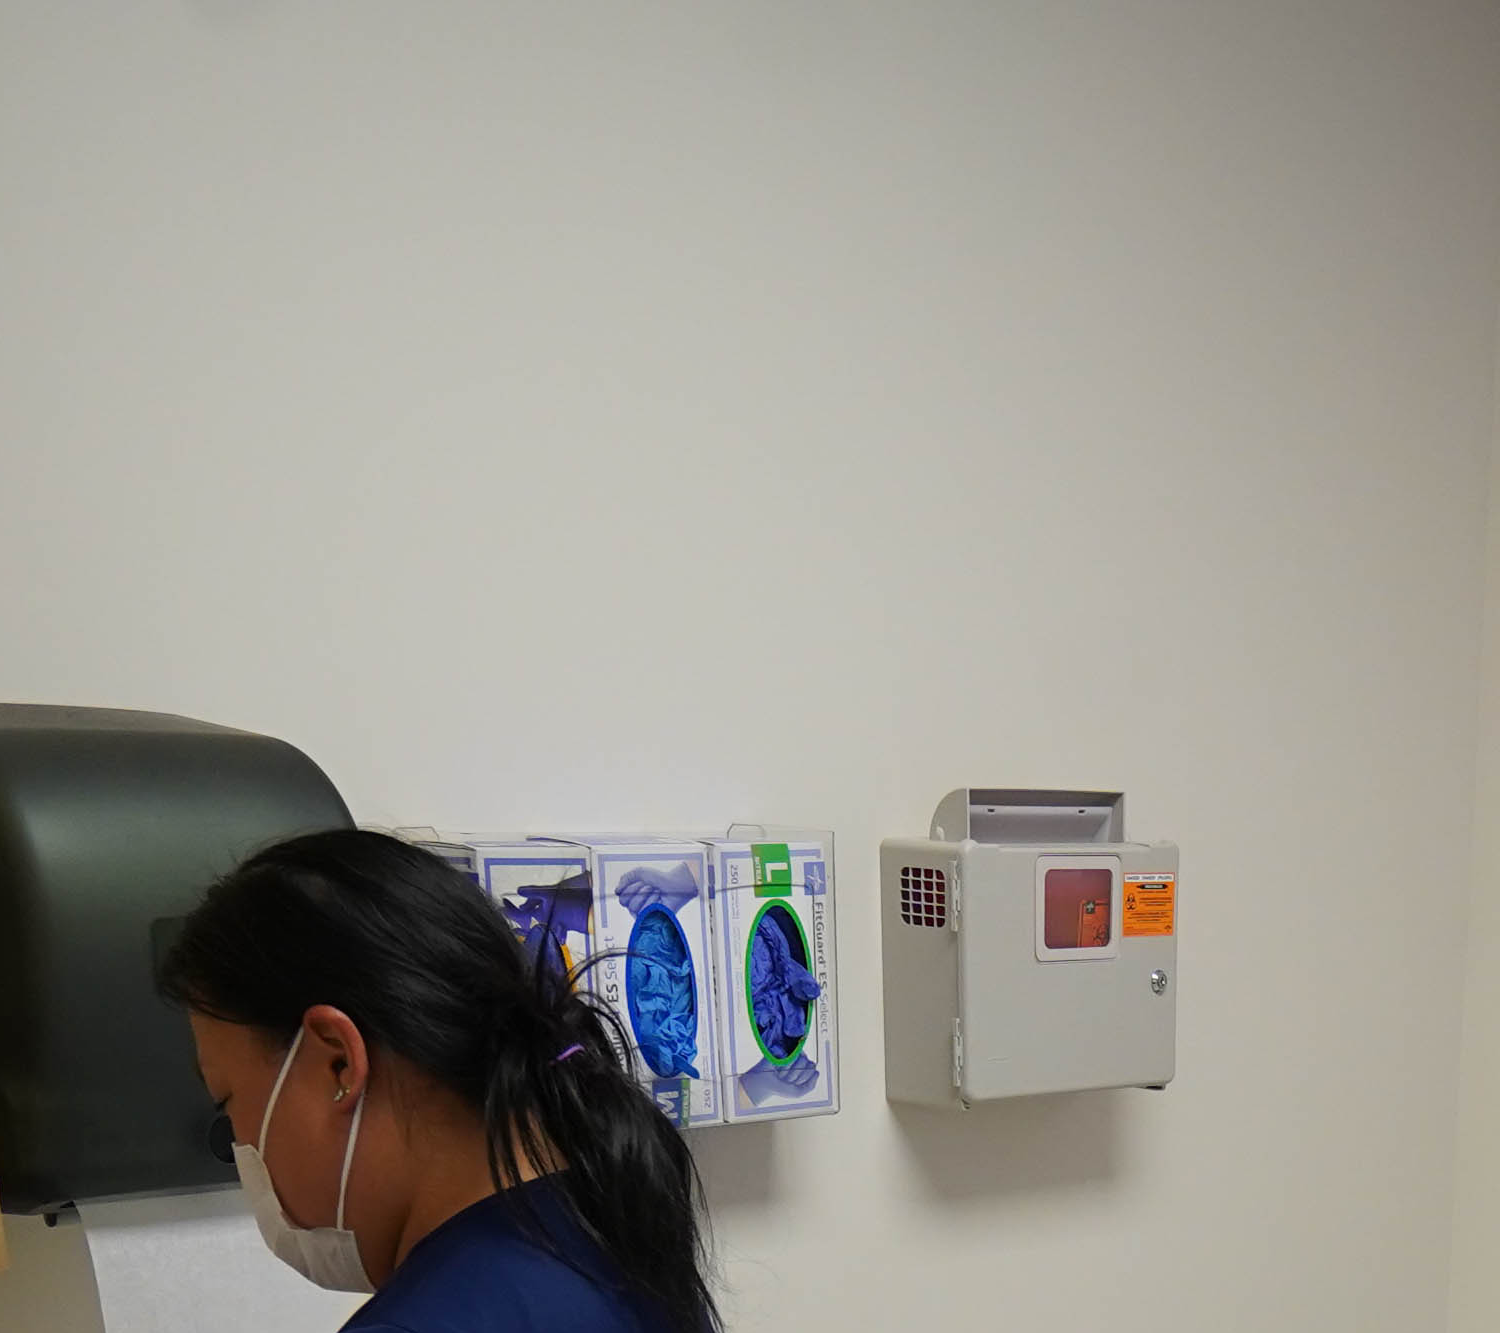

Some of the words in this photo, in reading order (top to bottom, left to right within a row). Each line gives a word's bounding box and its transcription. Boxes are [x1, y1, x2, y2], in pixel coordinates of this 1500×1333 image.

[730, 864, 739, 885] 250
[763, 862, 789, 884] L
[603, 935, 619, 980] Selct
[818, 972, 829, 991] ES
[605, 983, 619, 1003] ES
[819, 993, 829, 1034] Select
[656, 1091, 680, 1119] M
[703, 1089, 712, 1108] 250
